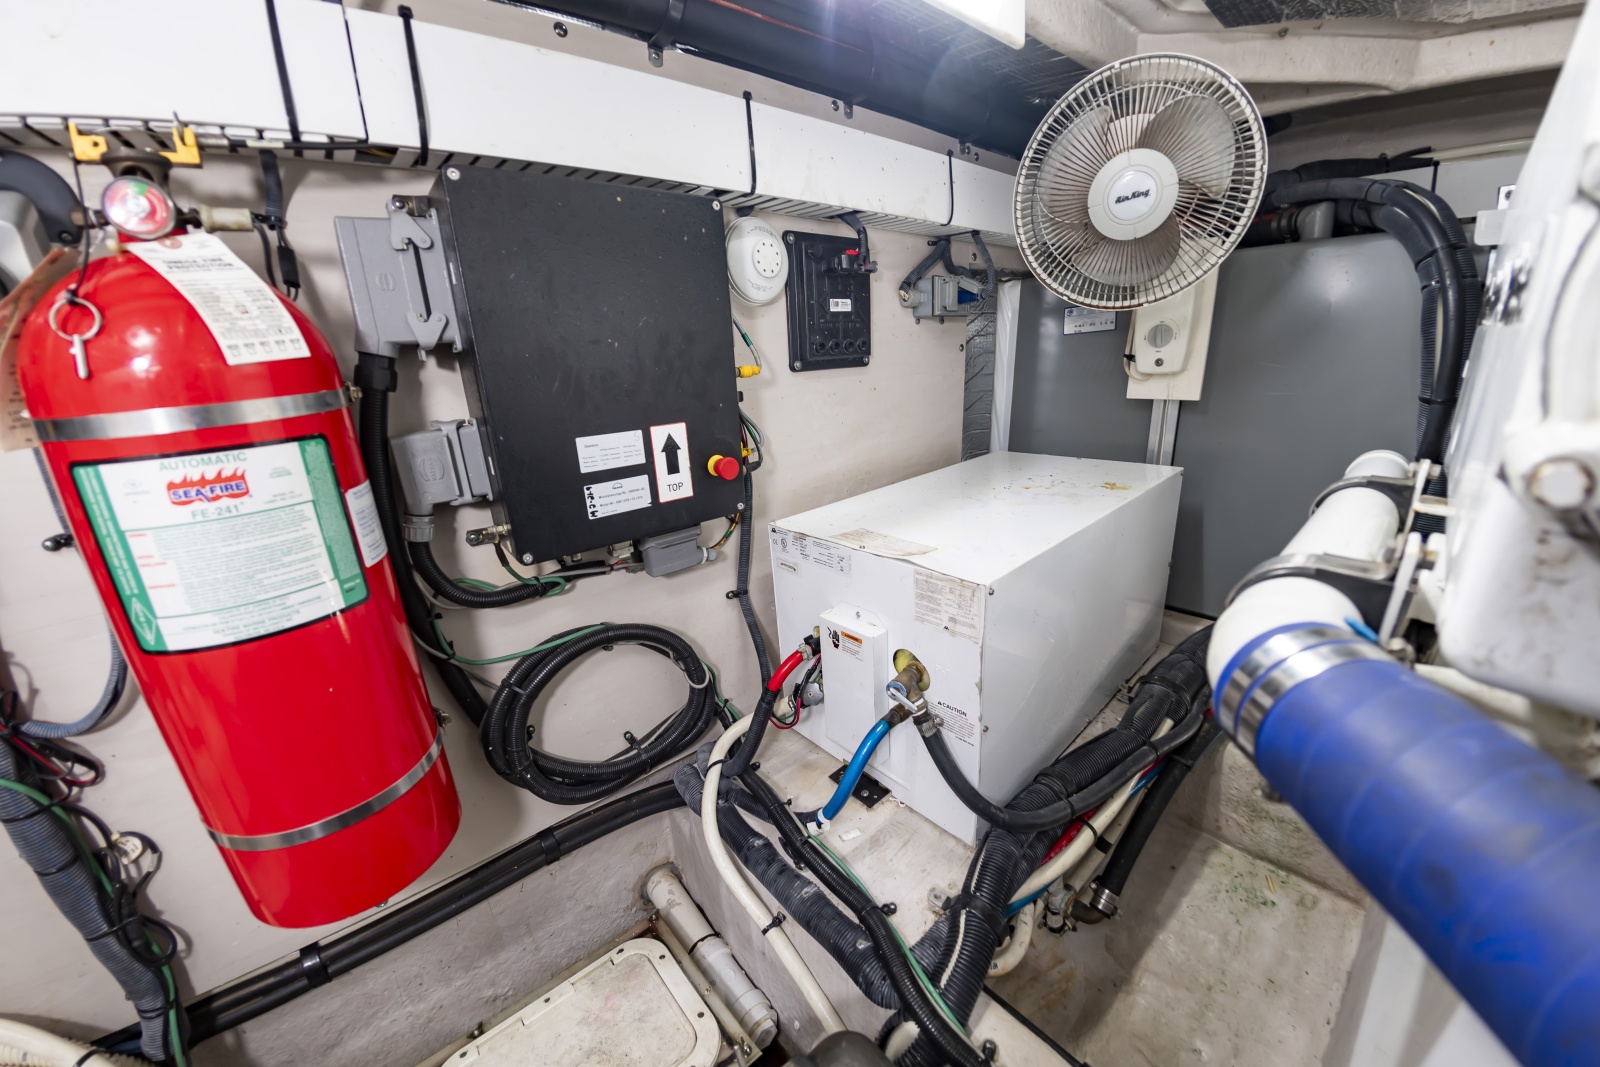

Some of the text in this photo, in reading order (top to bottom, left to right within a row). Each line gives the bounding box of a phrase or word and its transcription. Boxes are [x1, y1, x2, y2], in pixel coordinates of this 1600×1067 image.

[159, 451, 248, 471] AUTOMATIC
[666, 482, 684, 493] TOP
[190, 504, 241, 520] FE-241
[942, 702, 967, 717] CAUTION
